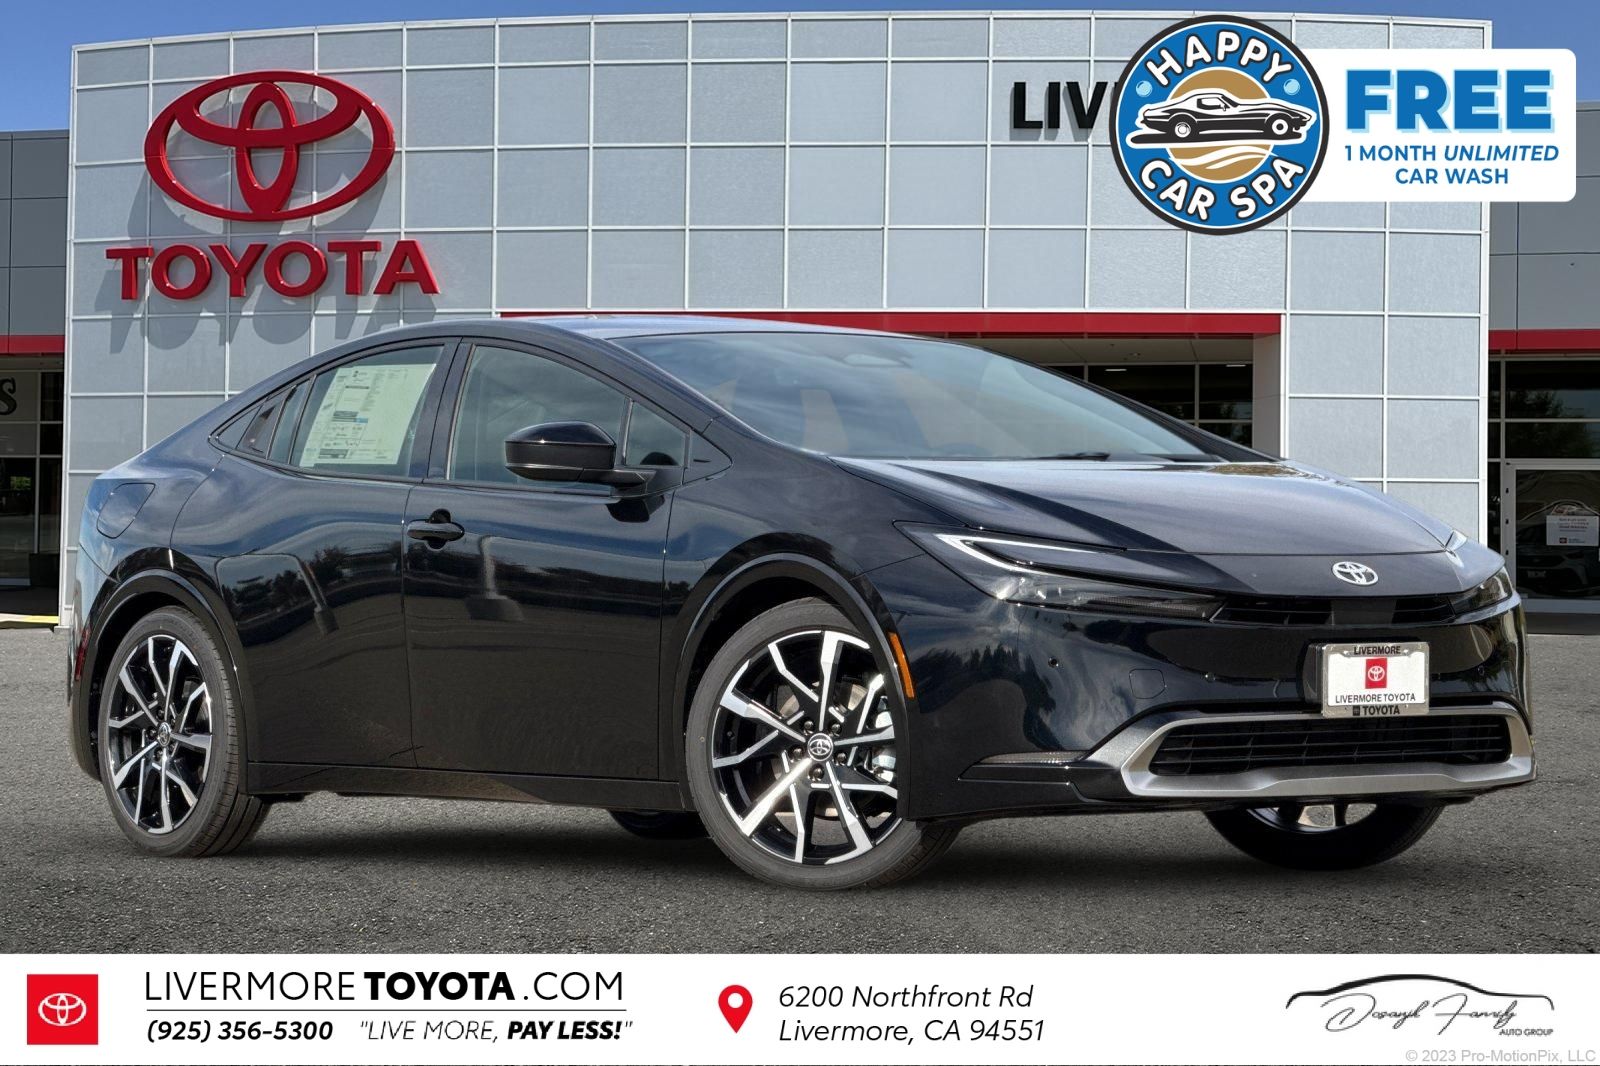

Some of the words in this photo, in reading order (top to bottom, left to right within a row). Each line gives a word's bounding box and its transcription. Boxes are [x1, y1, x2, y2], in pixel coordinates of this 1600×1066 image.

[105, 240, 441, 300] TOYOTA
[1353, 645, 1401, 655] LIVERMORE
[1335, 694, 1382, 704] LIVERMORE
[1384, 693, 1416, 703] TOYOTA
[1362, 705, 1401, 716] TOYOTA
